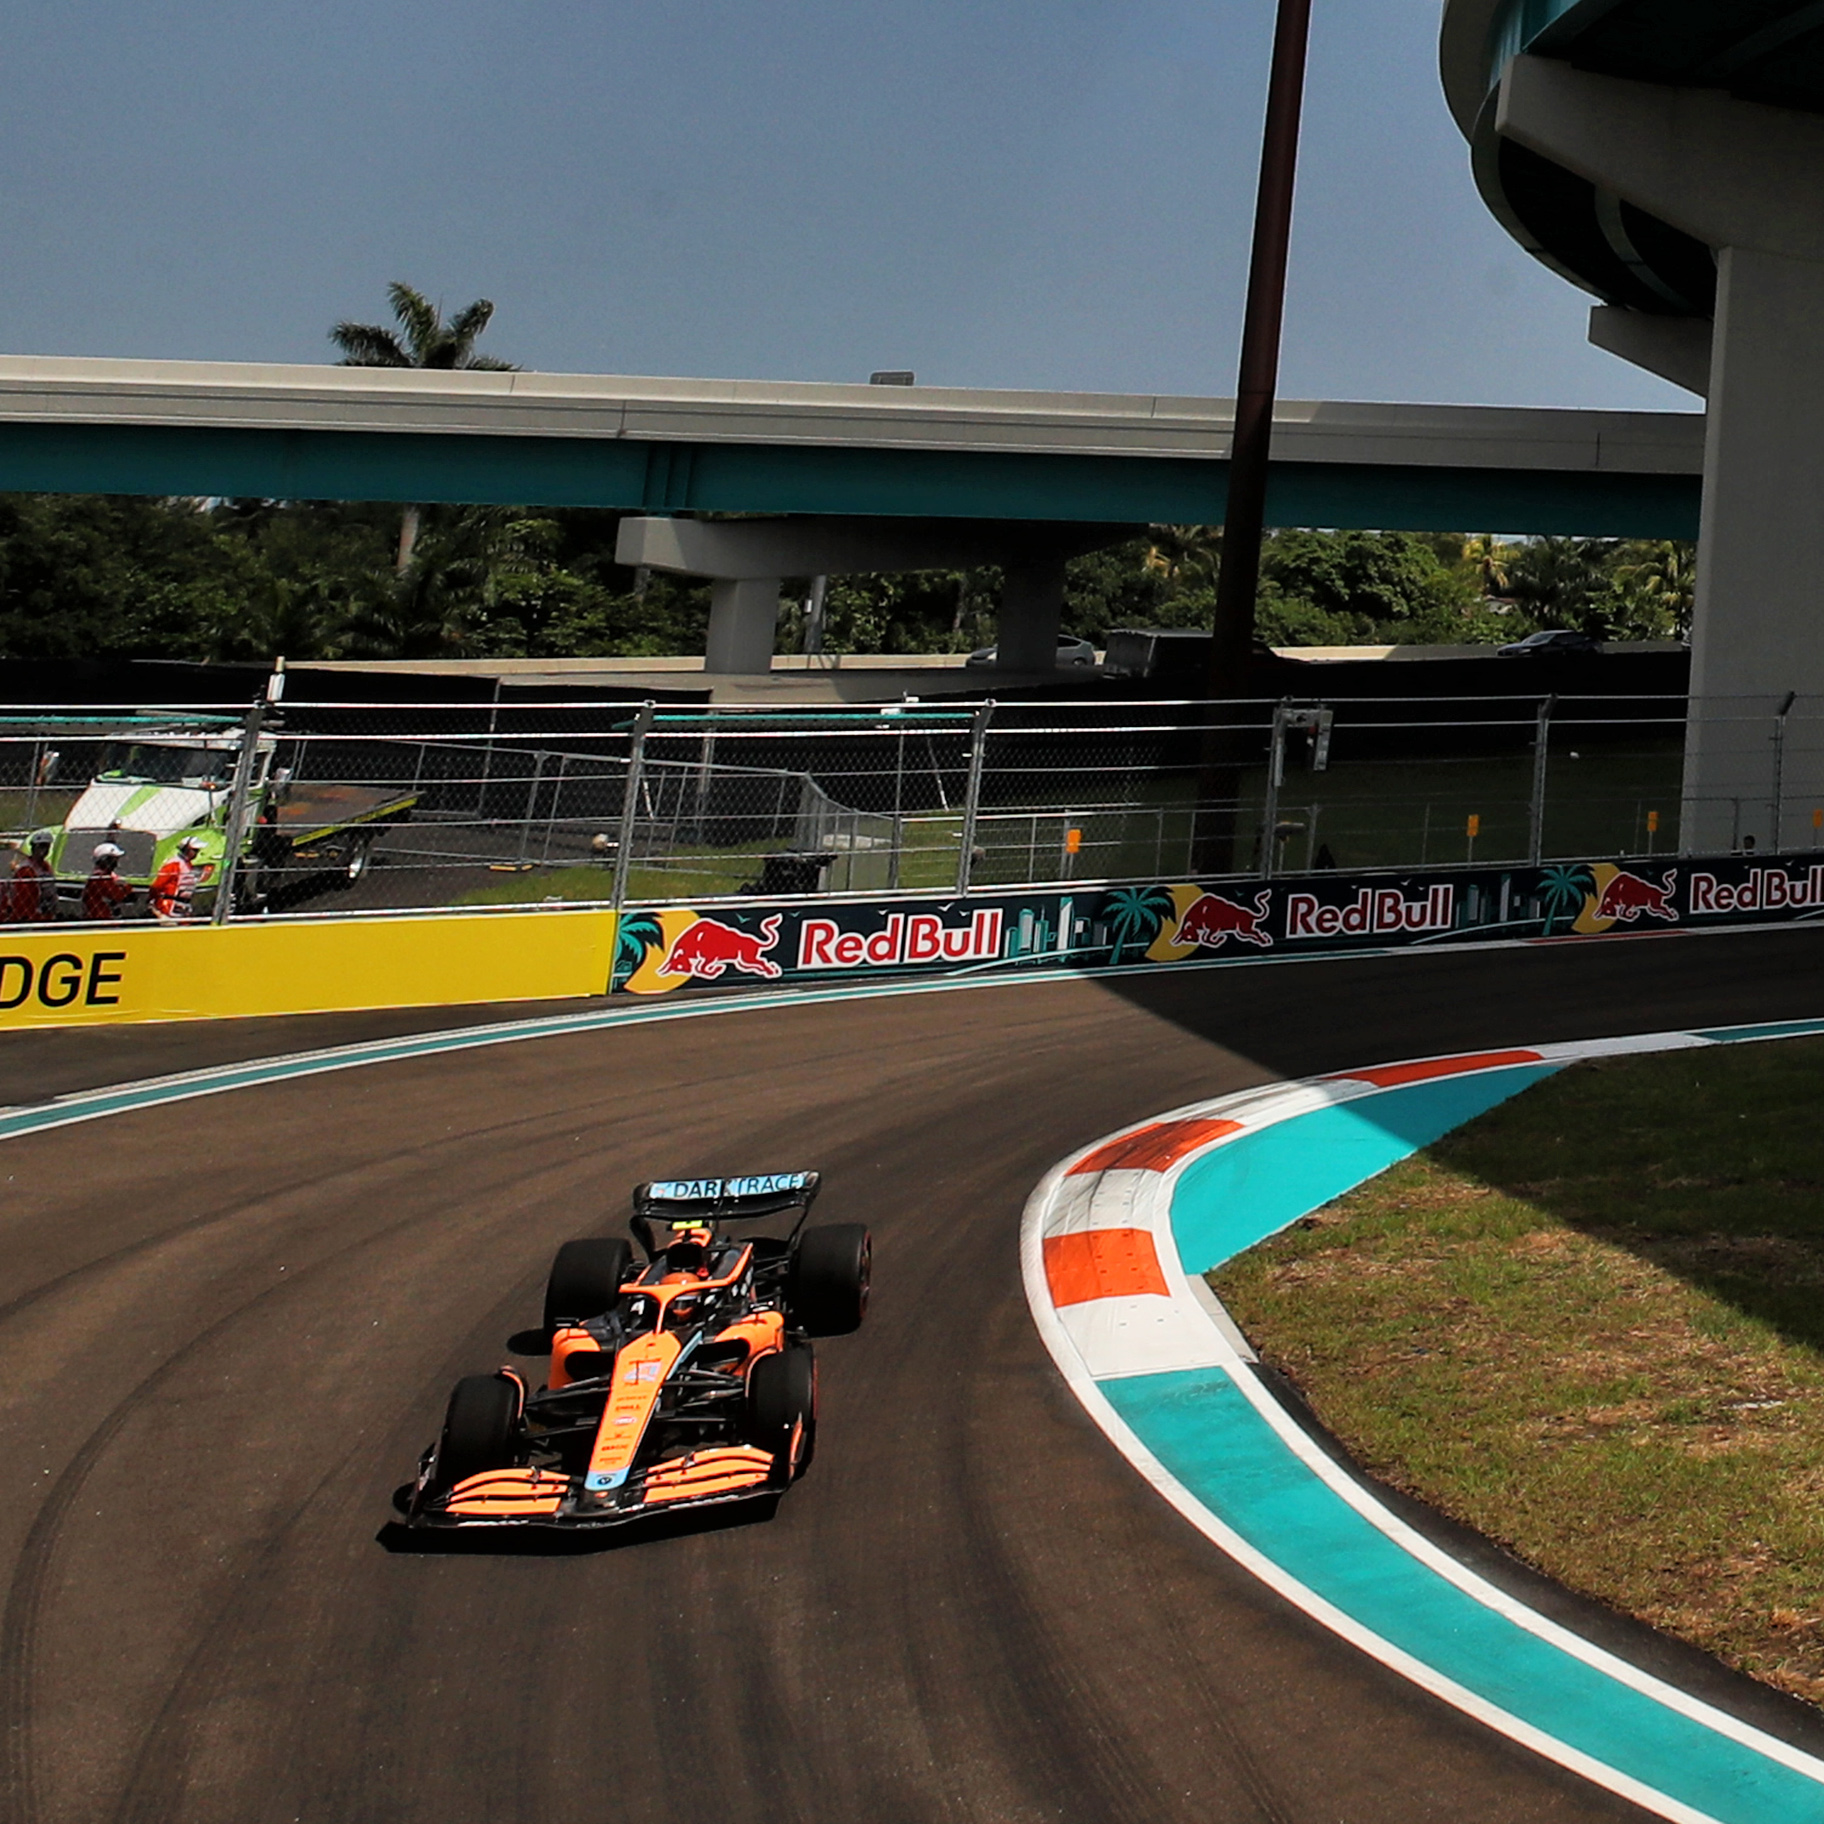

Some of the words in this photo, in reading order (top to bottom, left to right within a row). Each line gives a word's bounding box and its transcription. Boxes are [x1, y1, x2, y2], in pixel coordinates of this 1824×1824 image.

[1286, 888, 1372, 938] Red
[1373, 884, 1453, 933] Bull
[1690, 868, 1761, 914] Red
[798, 914, 904, 968] Red
[904, 908, 1003, 963] Bull
